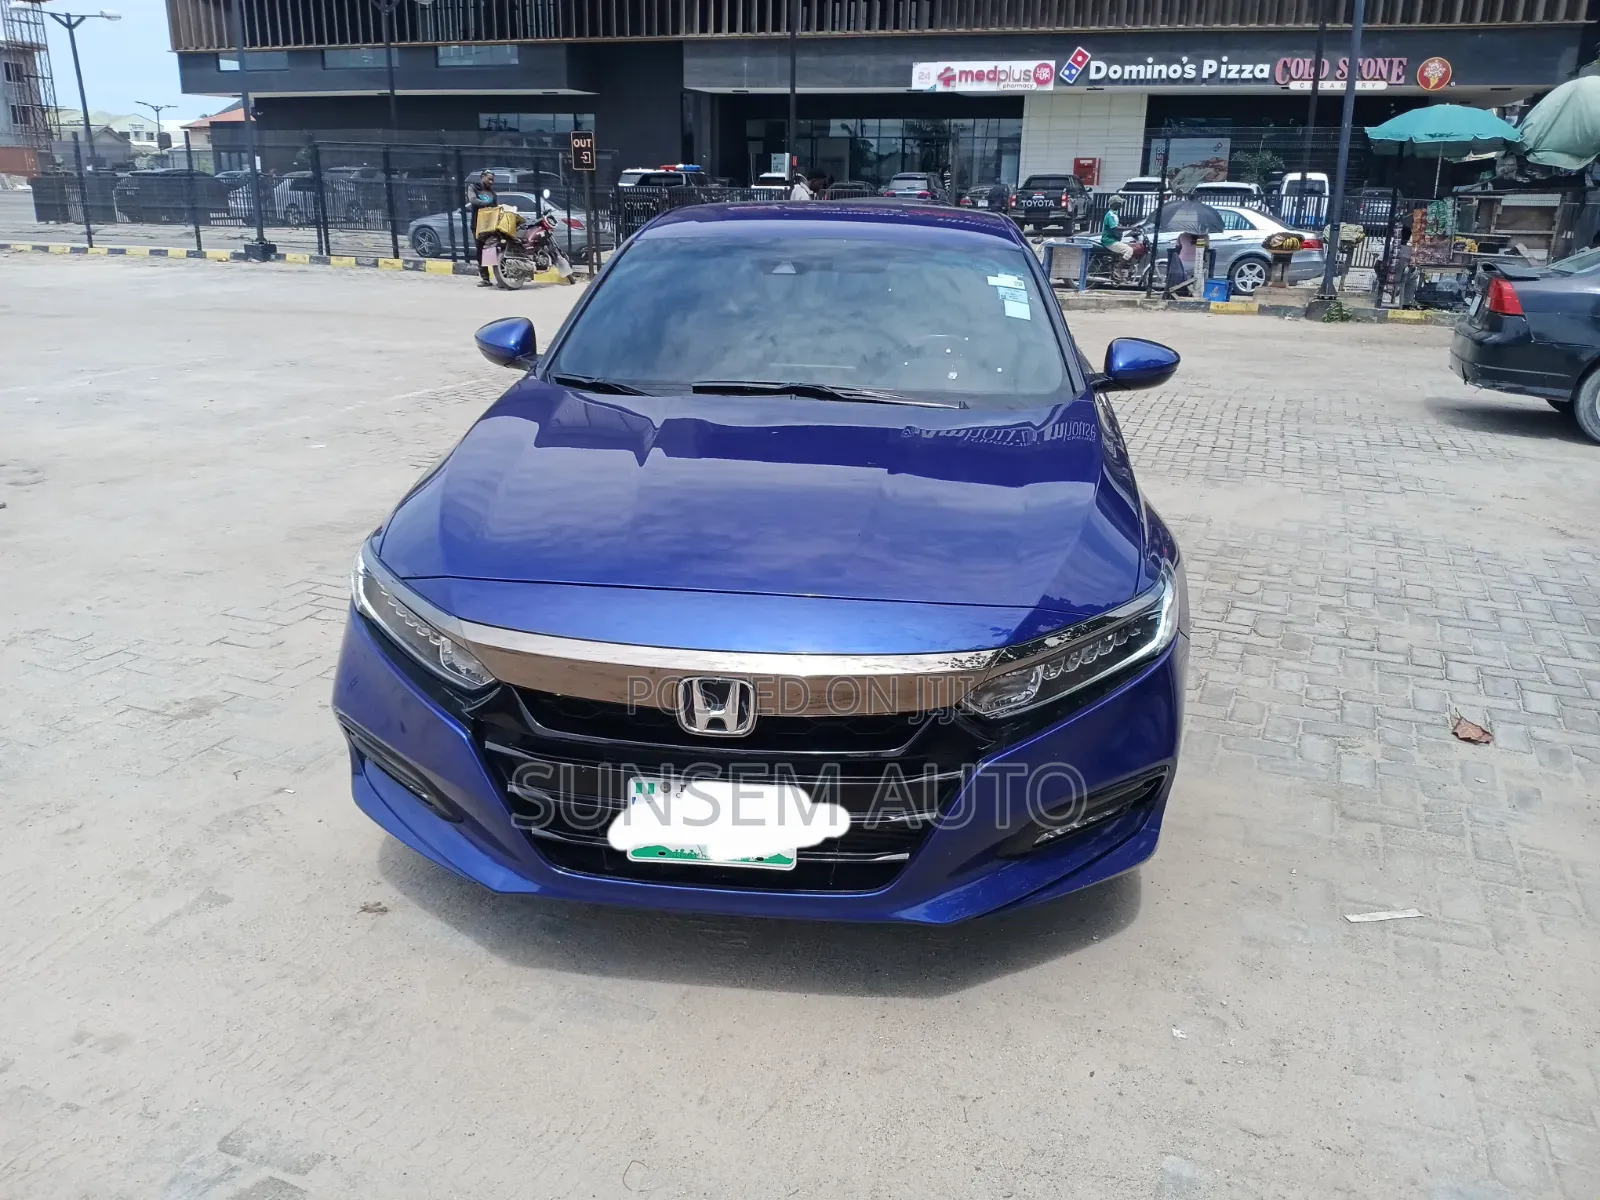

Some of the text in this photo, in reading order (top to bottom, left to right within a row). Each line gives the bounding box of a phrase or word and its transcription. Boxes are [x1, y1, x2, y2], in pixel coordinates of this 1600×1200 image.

[958, 65, 1032, 90] medplus
[1089, 56, 1270, 80] Domino's Pizza
[1275, 57, 1330, 85] COLD
[1002, 82, 1034, 90] pharmacy
[573, 138, 592, 148] OUT
